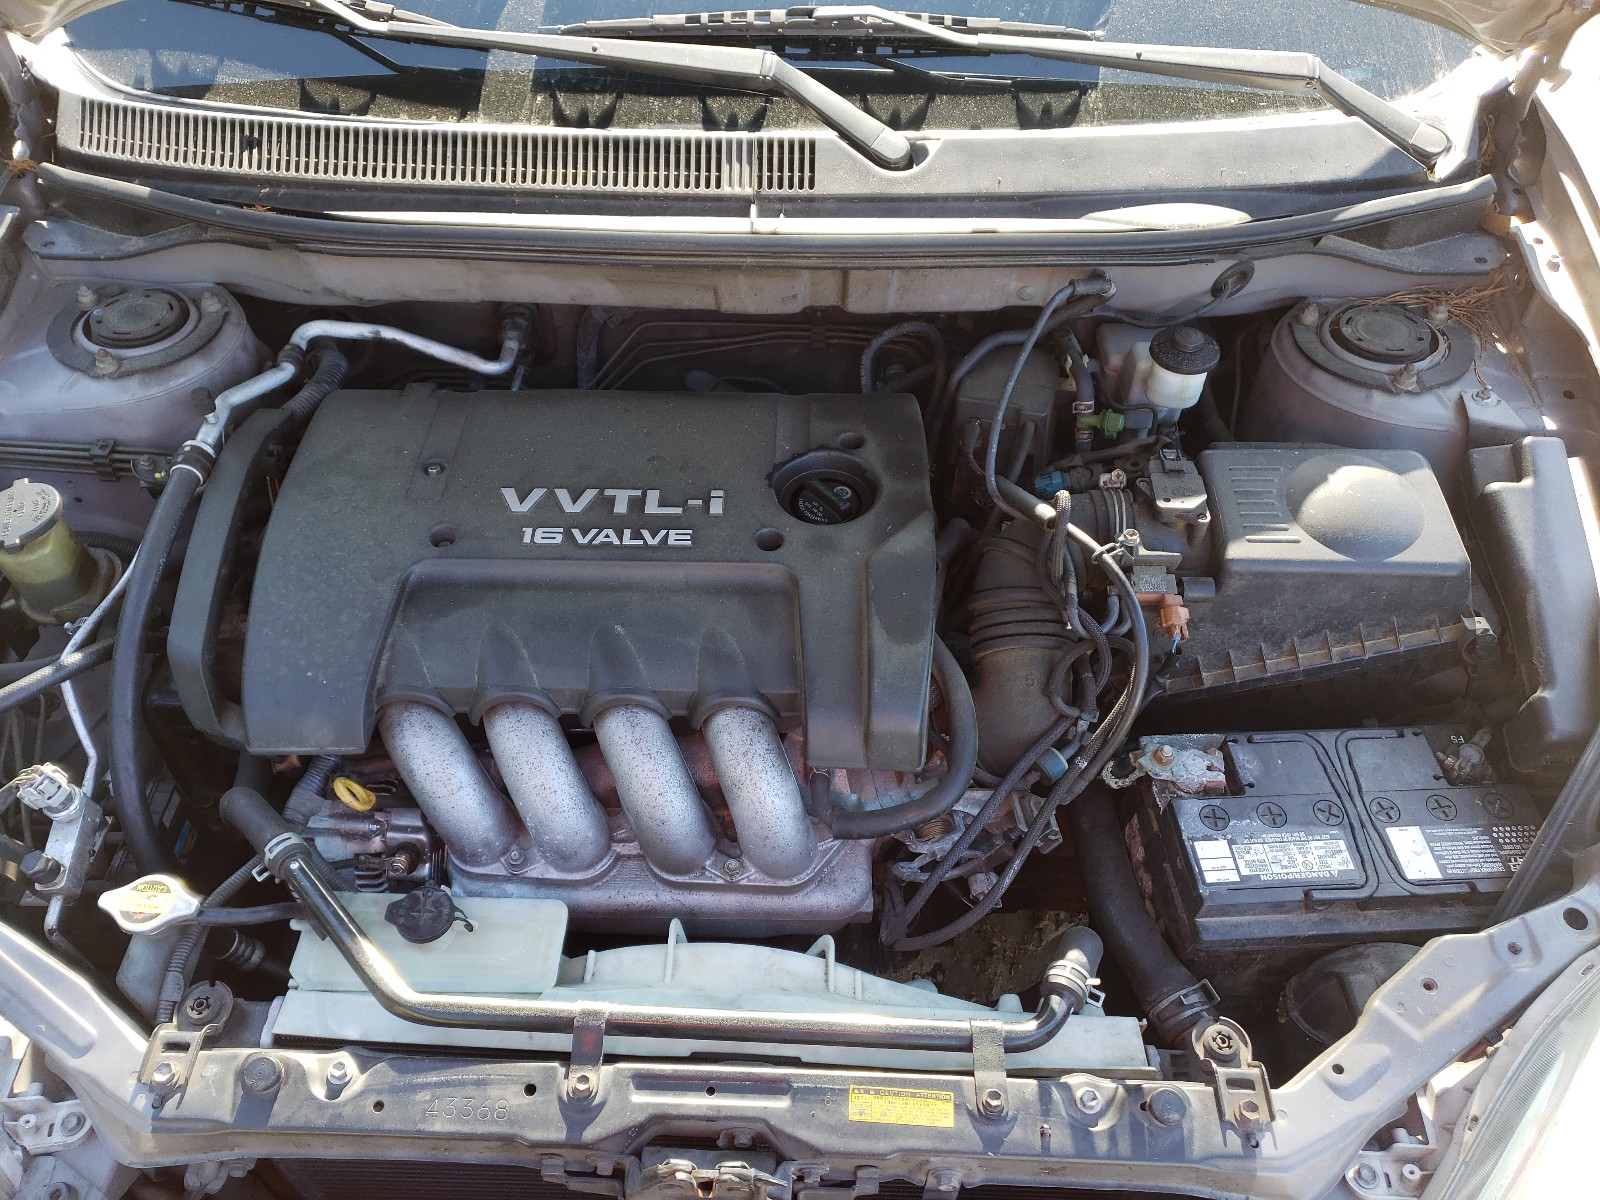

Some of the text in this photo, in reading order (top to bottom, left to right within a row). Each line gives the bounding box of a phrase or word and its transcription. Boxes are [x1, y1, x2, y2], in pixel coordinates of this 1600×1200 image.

[500, 487, 725, 516] VVTL-i
[521, 527, 693, 546] 16 VALVE
[1259, 871, 1331, 881] DANGER/POISON
[136, 883, 167, 893] CAUTION
[915, 1092, 950, 1100] ATTENTION
[424, 1096, 509, 1121] 43368
